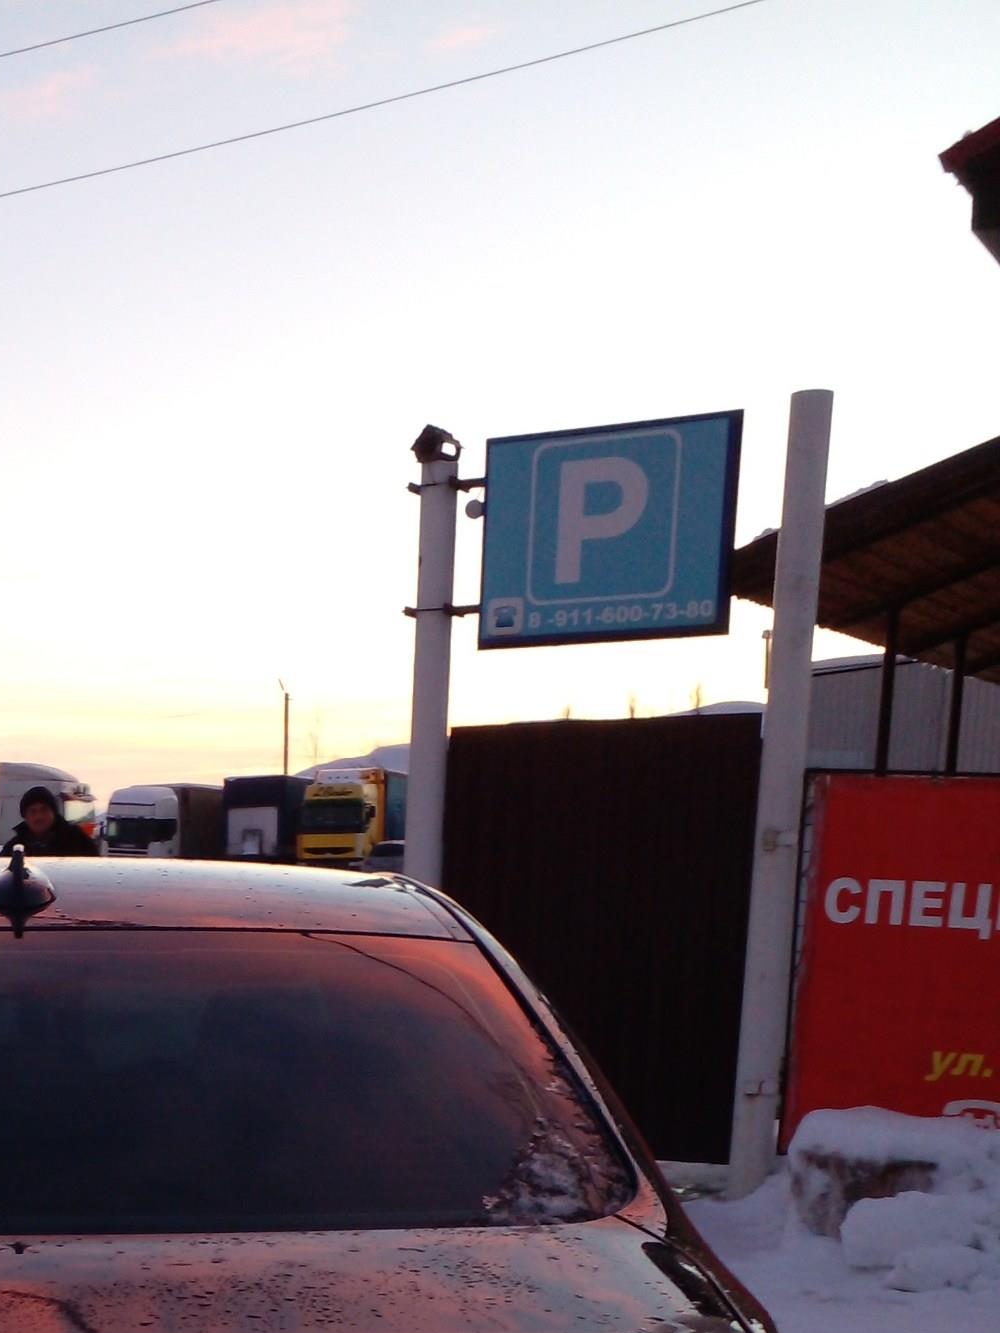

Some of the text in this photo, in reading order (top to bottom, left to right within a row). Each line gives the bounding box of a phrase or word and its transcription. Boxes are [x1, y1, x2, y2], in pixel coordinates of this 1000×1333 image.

[555, 456, 650, 584] P
[824, 876, 1000, 941] СПЕЦ
[924, 1050, 994, 1082] ул.
